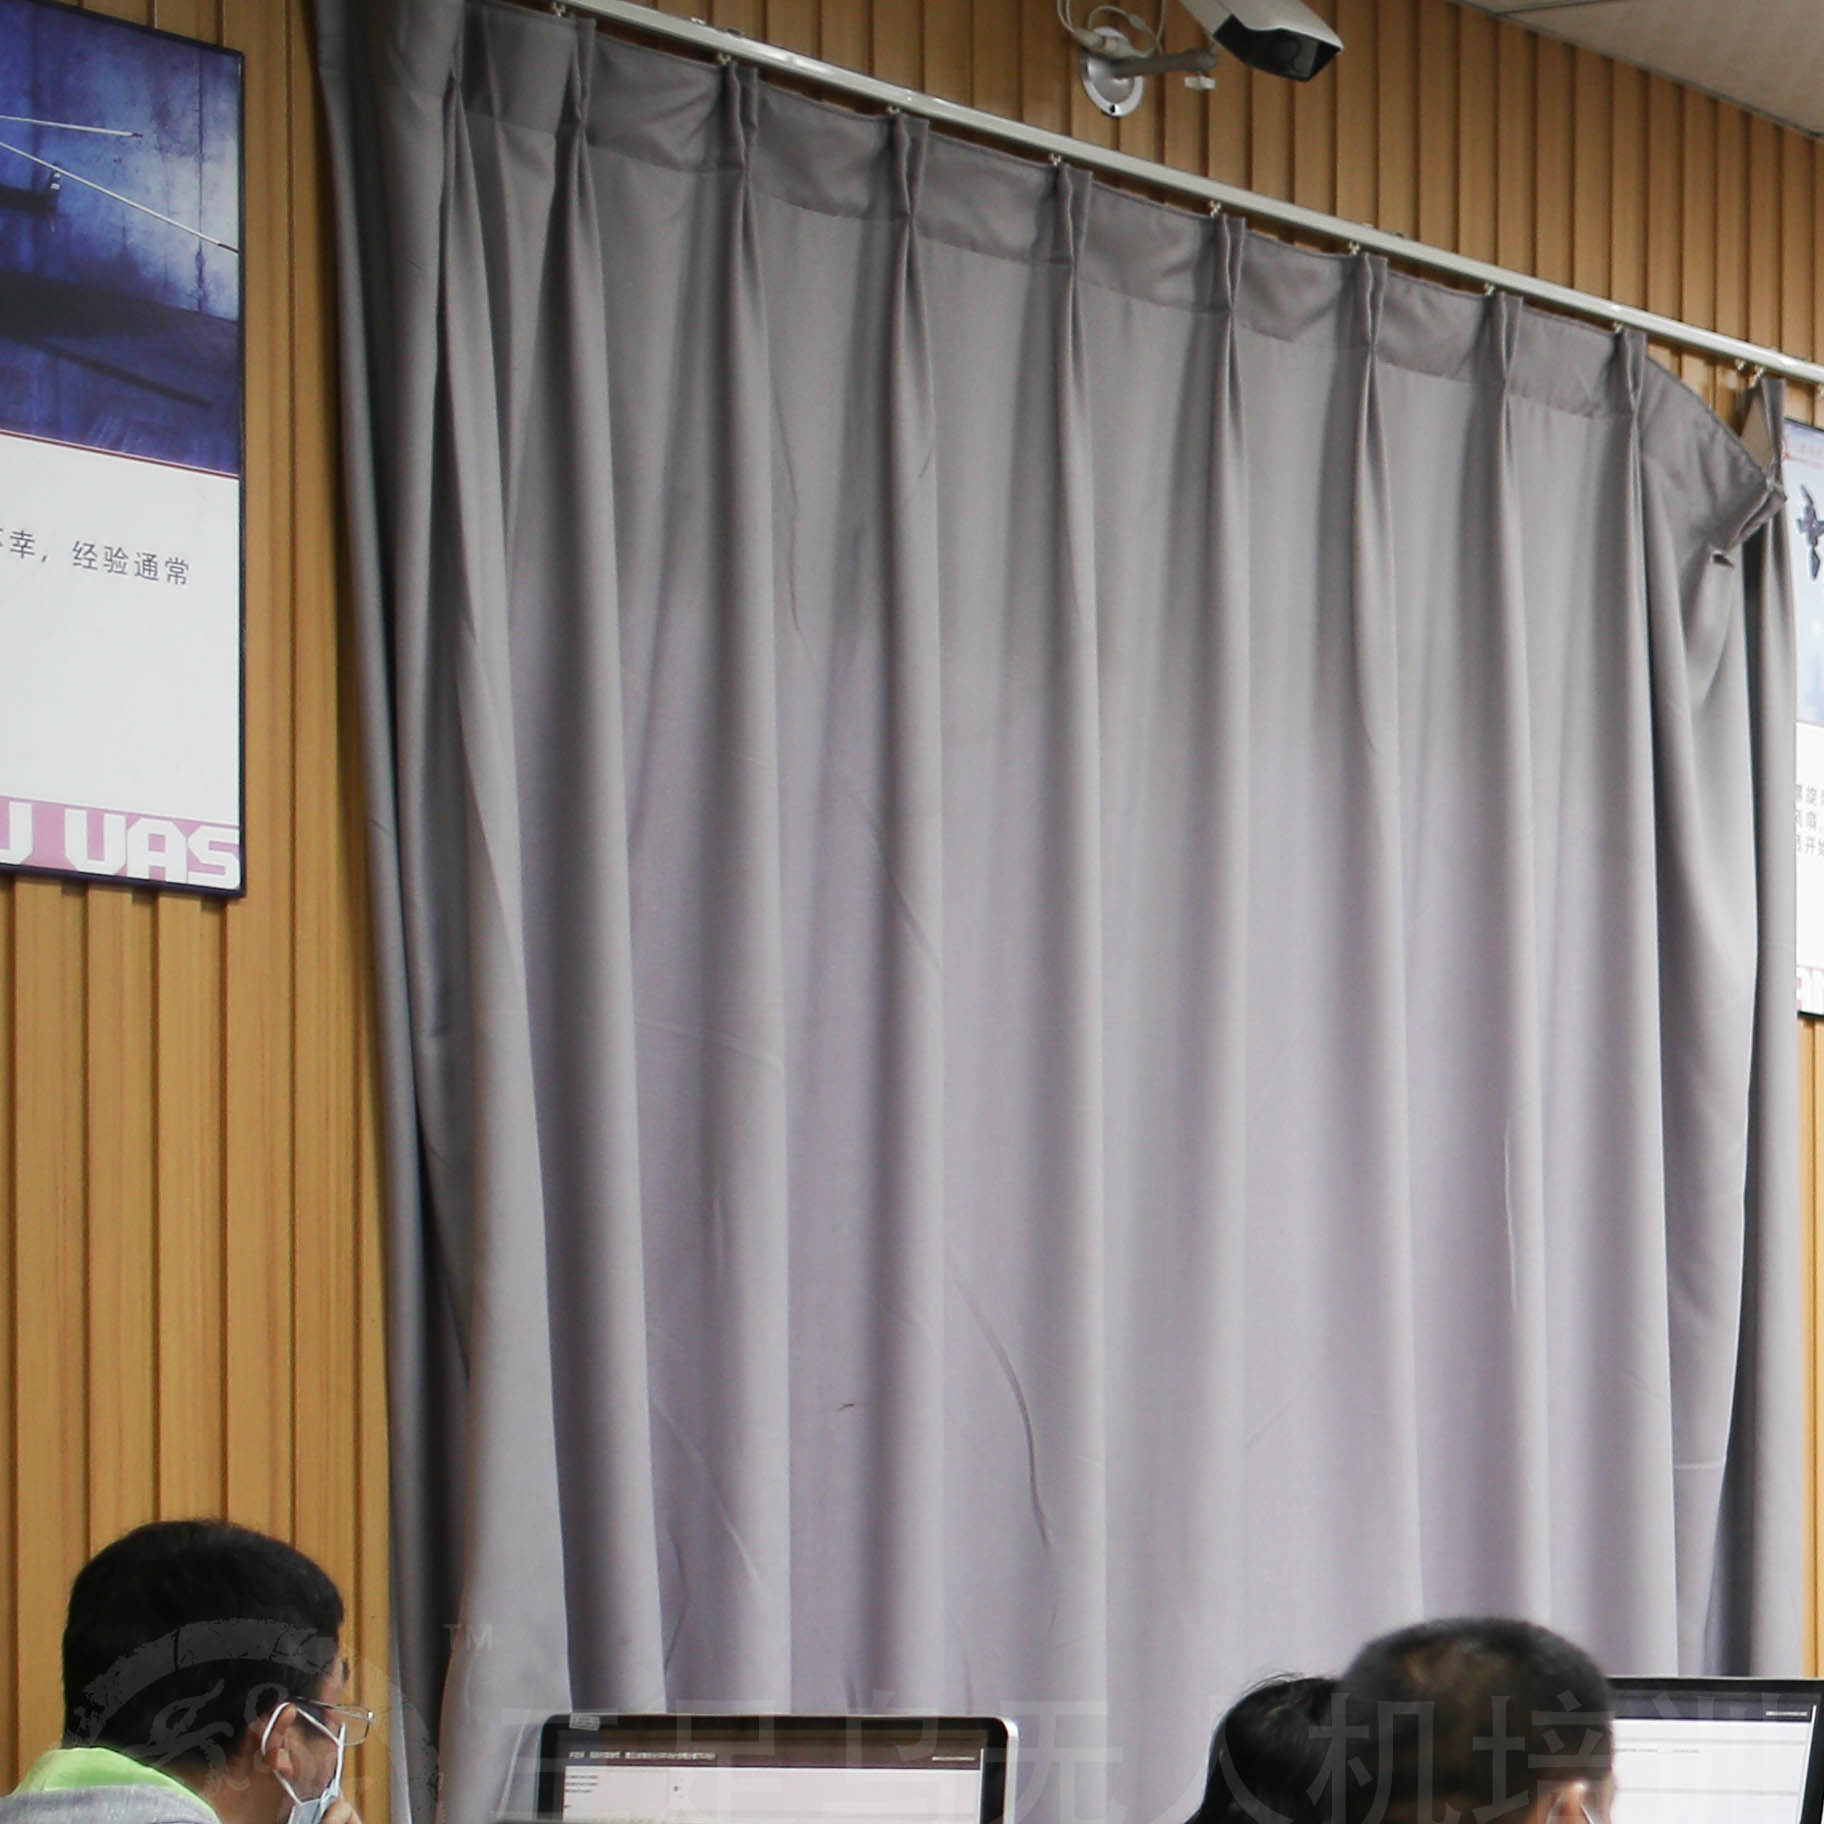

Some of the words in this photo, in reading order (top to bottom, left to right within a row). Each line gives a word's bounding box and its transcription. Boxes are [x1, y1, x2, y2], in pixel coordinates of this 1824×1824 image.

[0, 526, 190, 586] 幸，经验通常
[64, 807, 241, 890] UAS
